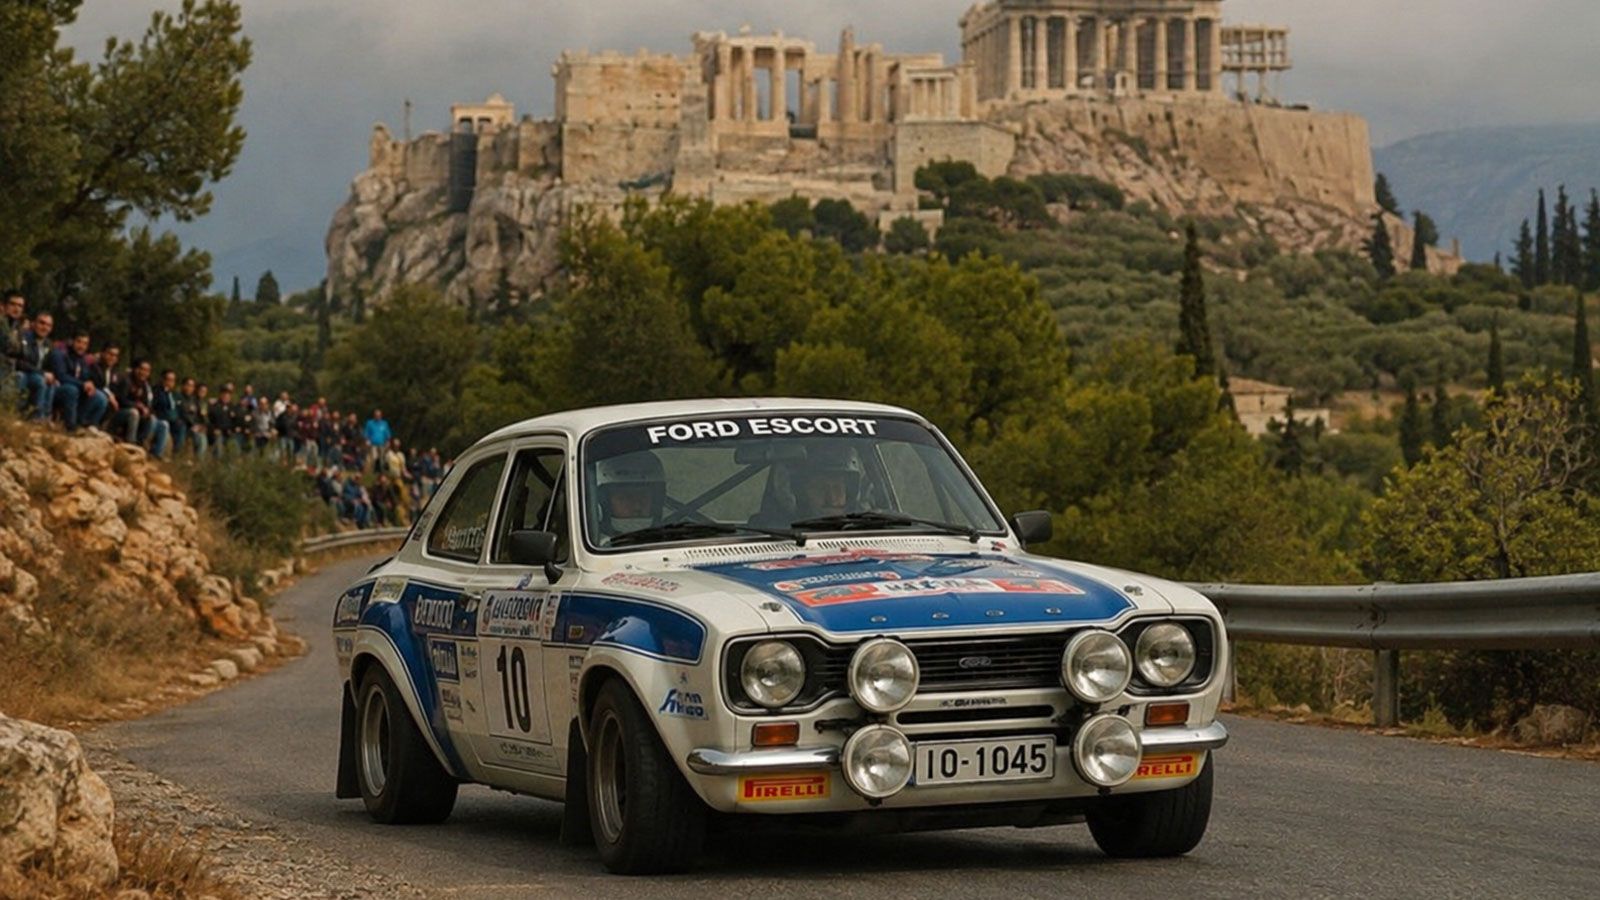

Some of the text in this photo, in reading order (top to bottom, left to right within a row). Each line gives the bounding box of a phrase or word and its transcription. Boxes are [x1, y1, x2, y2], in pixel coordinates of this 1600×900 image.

[647, 417, 877, 443] FORD ESCORT
[496, 645, 531, 733] 10
[1136, 755, 1193, 776] RELLI
[744, 776, 825, 798] PIRELLI
